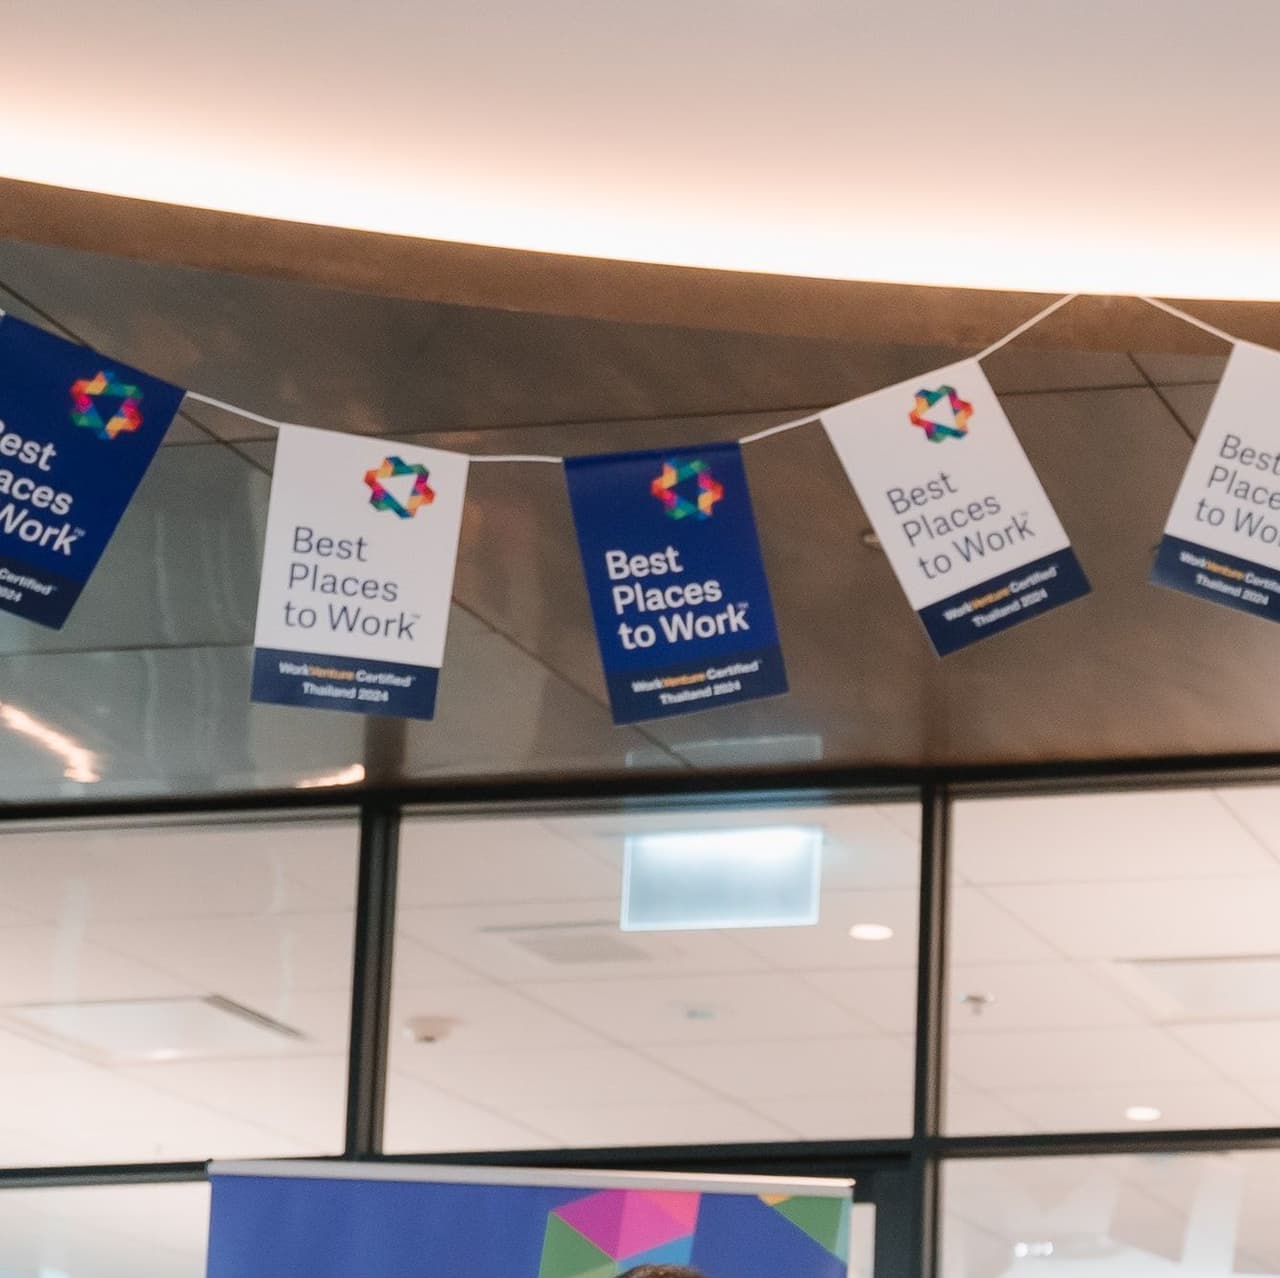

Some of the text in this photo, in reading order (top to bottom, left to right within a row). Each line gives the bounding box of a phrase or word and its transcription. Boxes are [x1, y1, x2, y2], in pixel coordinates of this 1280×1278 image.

[0, 420, 57, 471] est
[0, 468, 73, 515] aces
[886, 472, 958, 515] Best
[901, 496, 1001, 547] Places
[1195, 498, 1226, 527] to
[293, 526, 367, 562] Best
[605, 546, 684, 580] Best
[918, 516, 1035, 580] to Work
[288, 562, 398, 603] Places
[612, 580, 722, 615] Places
[1196, 573, 1242, 597] Thailand
[284, 601, 415, 641] to Work
[617, 603, 750, 650] to Work
[971, 599, 1021, 627] Thailand
[302, 681, 357, 700] Thailand
[659, 685, 712, 705] Thailand
